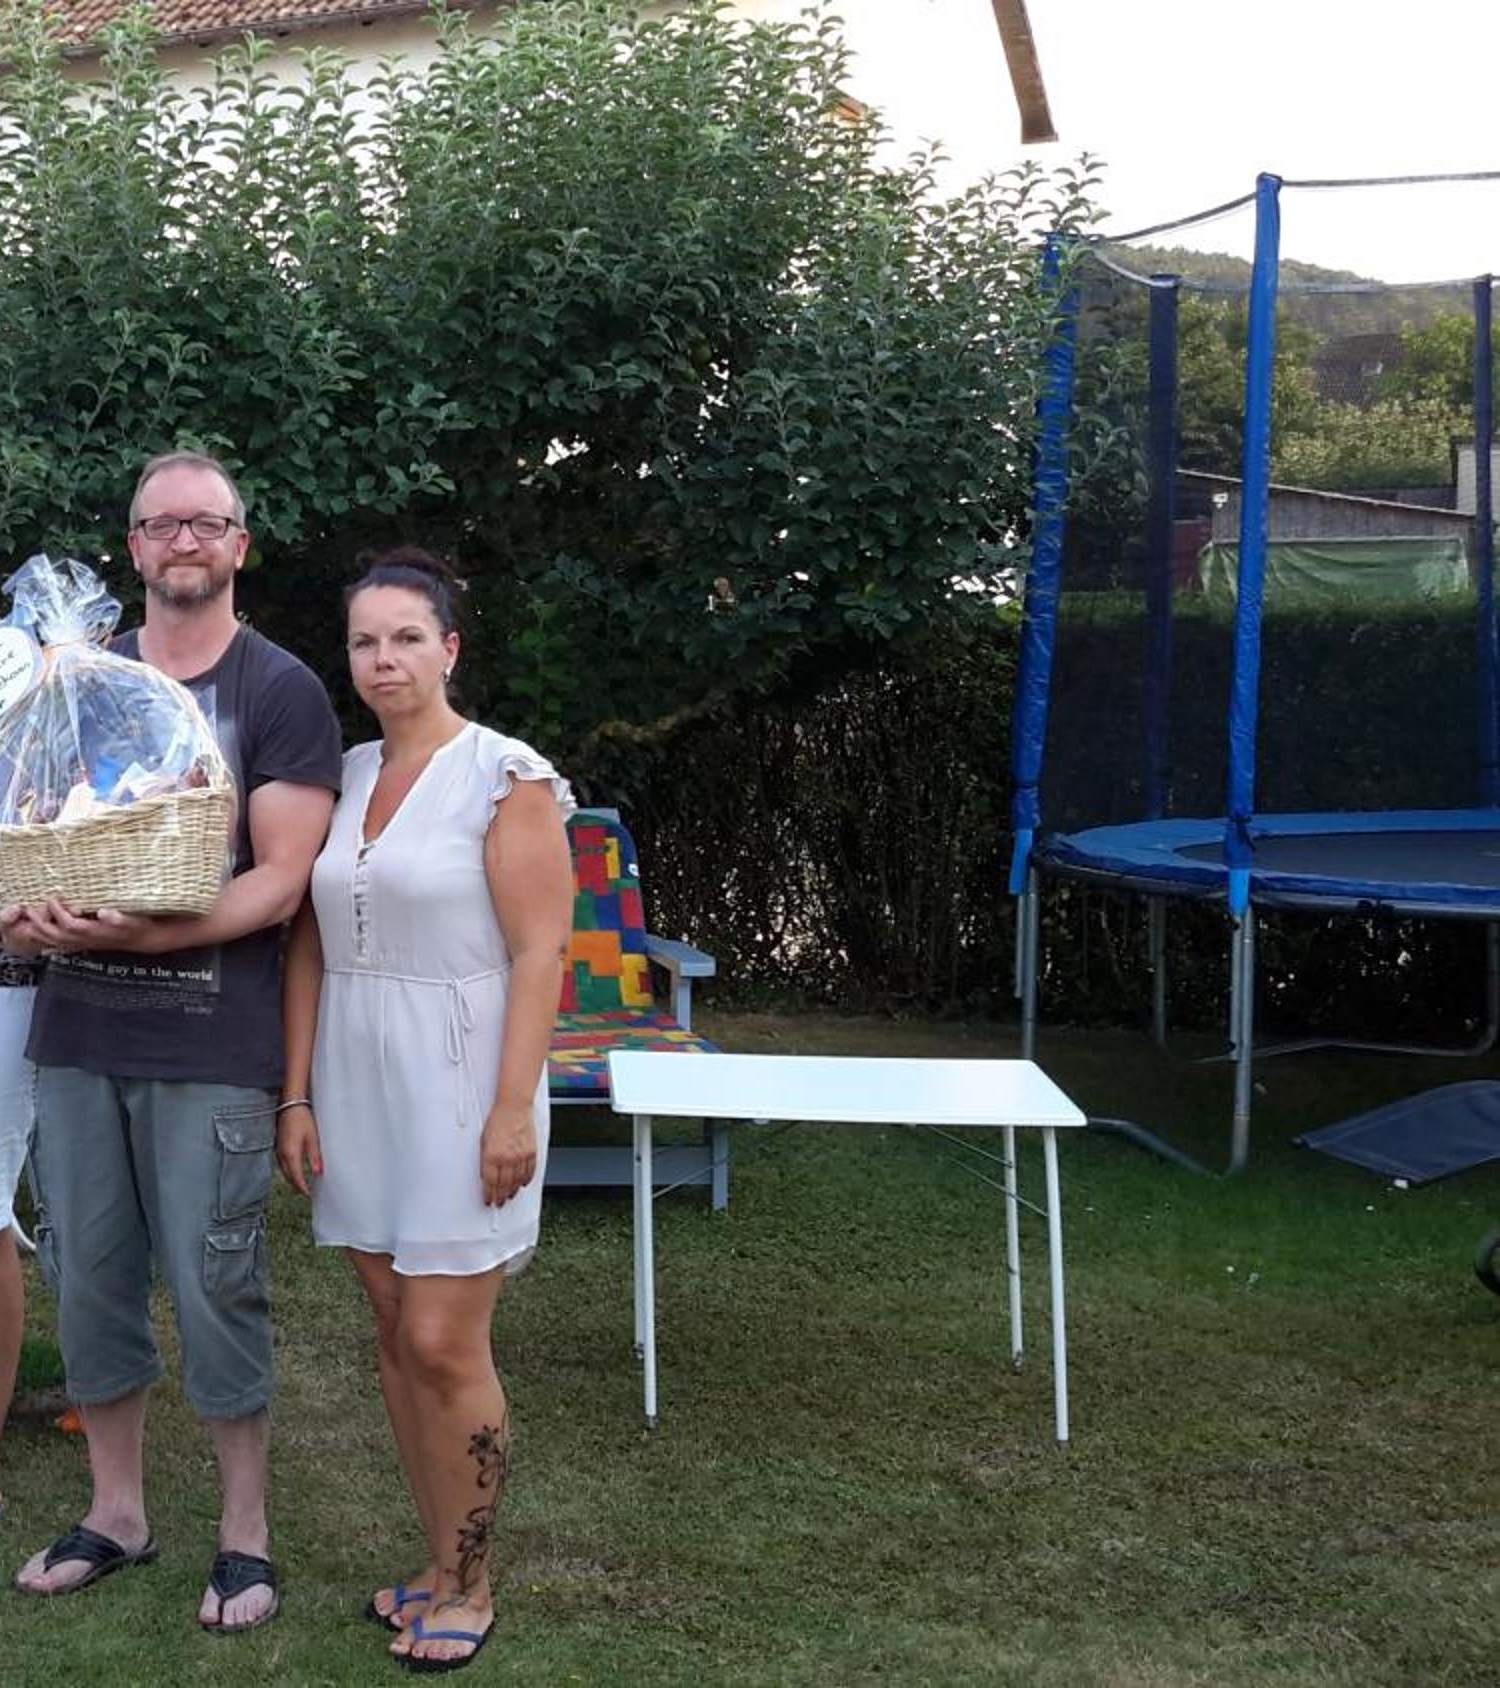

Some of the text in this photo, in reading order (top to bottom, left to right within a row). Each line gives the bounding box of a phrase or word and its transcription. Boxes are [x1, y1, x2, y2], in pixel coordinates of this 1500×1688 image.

[107, 964, 131, 978] guy
[133, 966, 147, 976] in
[151, 966, 173, 978] the
[177, 969, 214, 982] world
